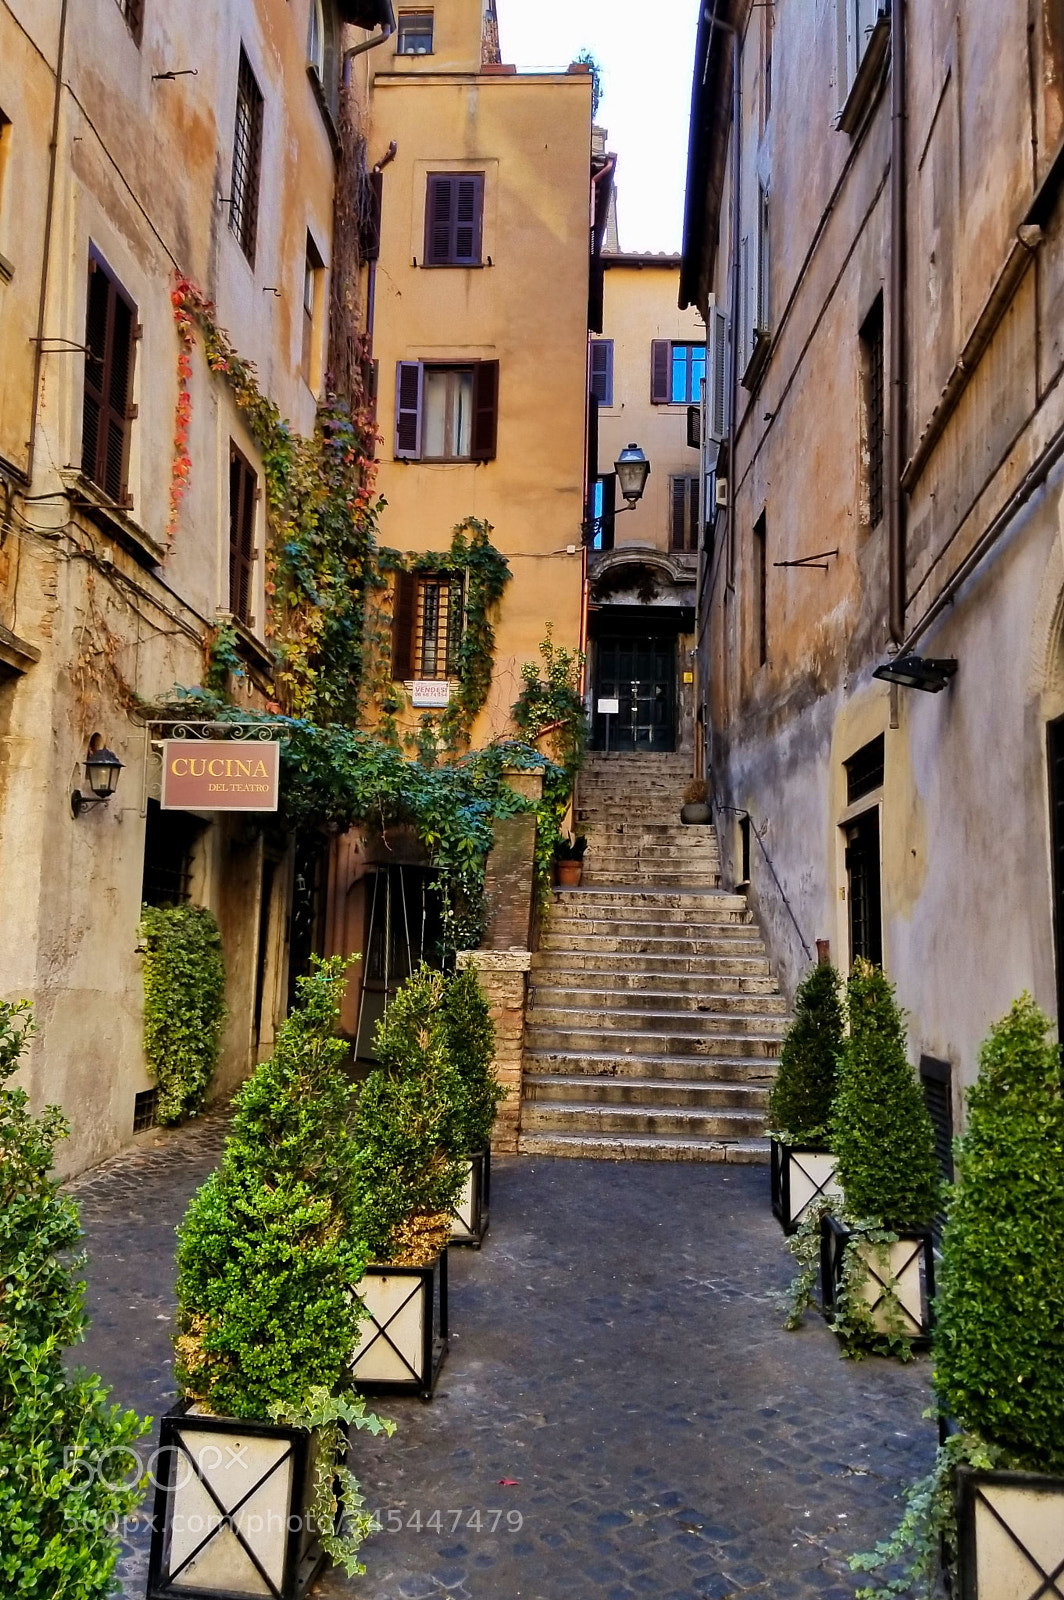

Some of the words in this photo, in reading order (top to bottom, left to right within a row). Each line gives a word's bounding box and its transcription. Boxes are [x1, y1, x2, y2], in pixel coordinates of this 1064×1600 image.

[171, 758, 269, 778] CUCINA
[208, 783, 229, 792] DEL
[230, 783, 269, 793] TEATRO
